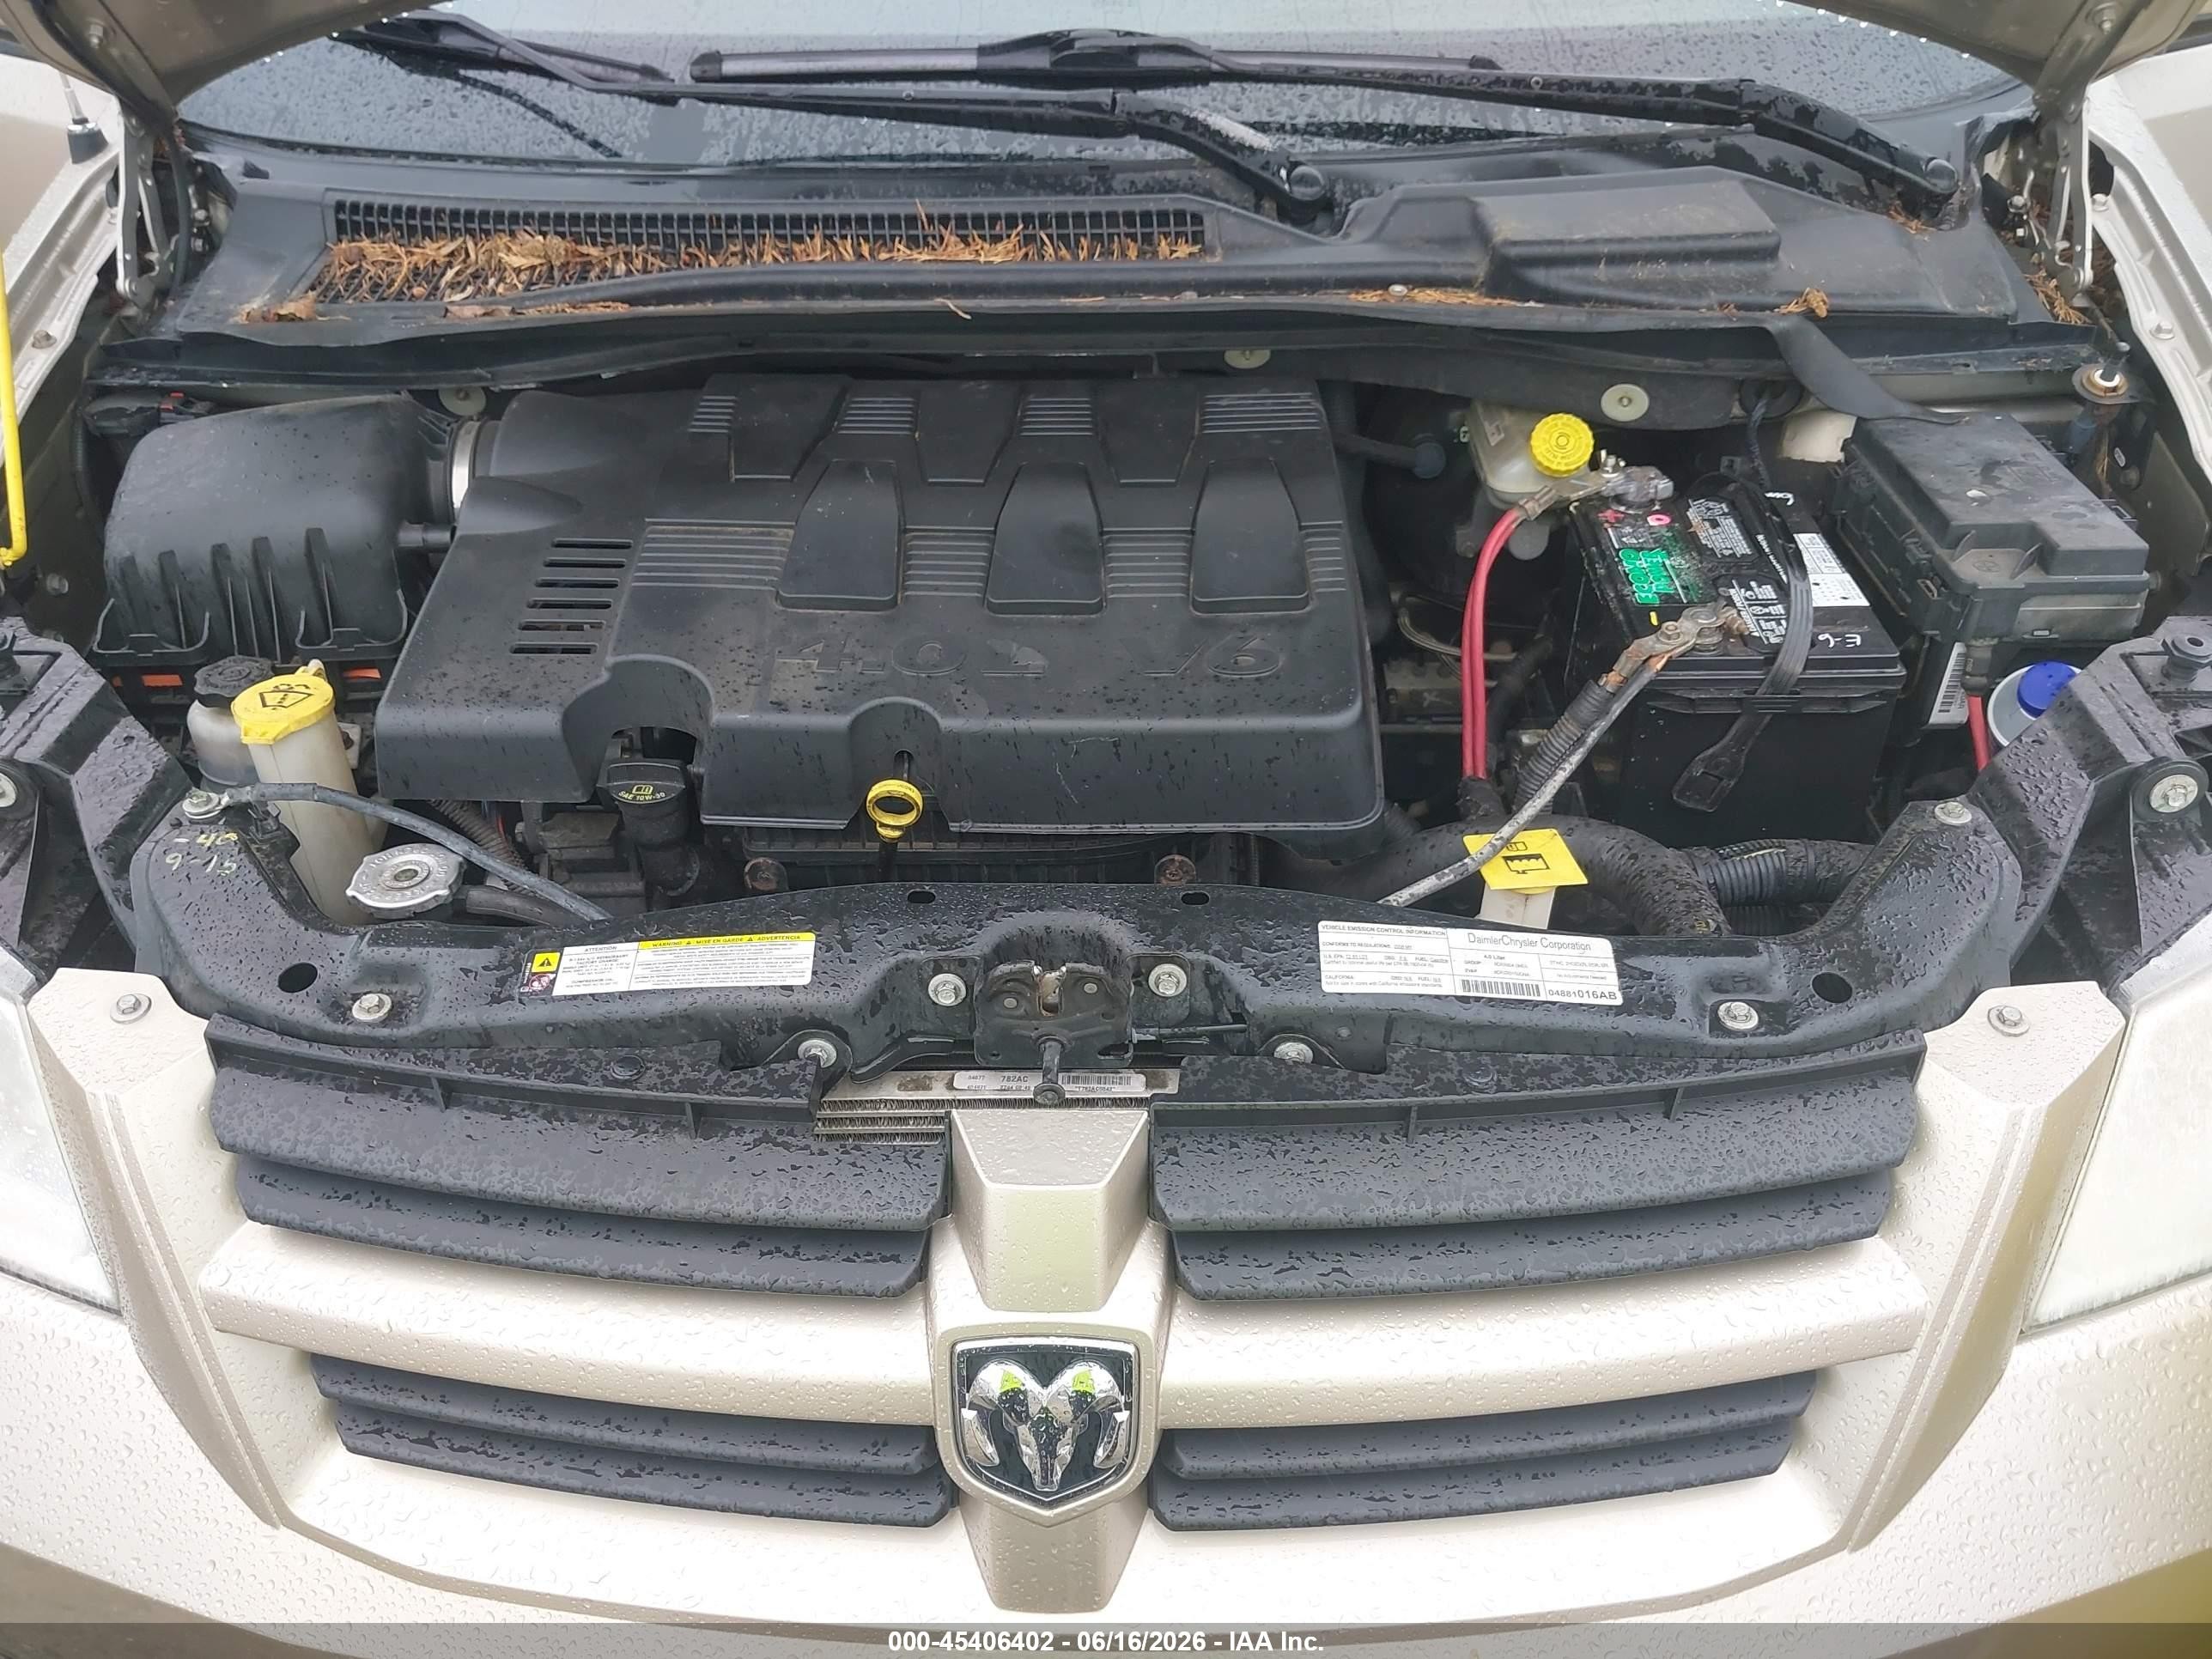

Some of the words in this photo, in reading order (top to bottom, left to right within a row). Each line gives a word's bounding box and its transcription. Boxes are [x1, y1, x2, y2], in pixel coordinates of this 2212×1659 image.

[618, 790, 635, 800] SAE
[1467, 933, 1538, 948] DaimlerChrysler
[1540, 937, 1591, 952] Corporation
[1547, 989, 1618, 1000] 04881016AB
